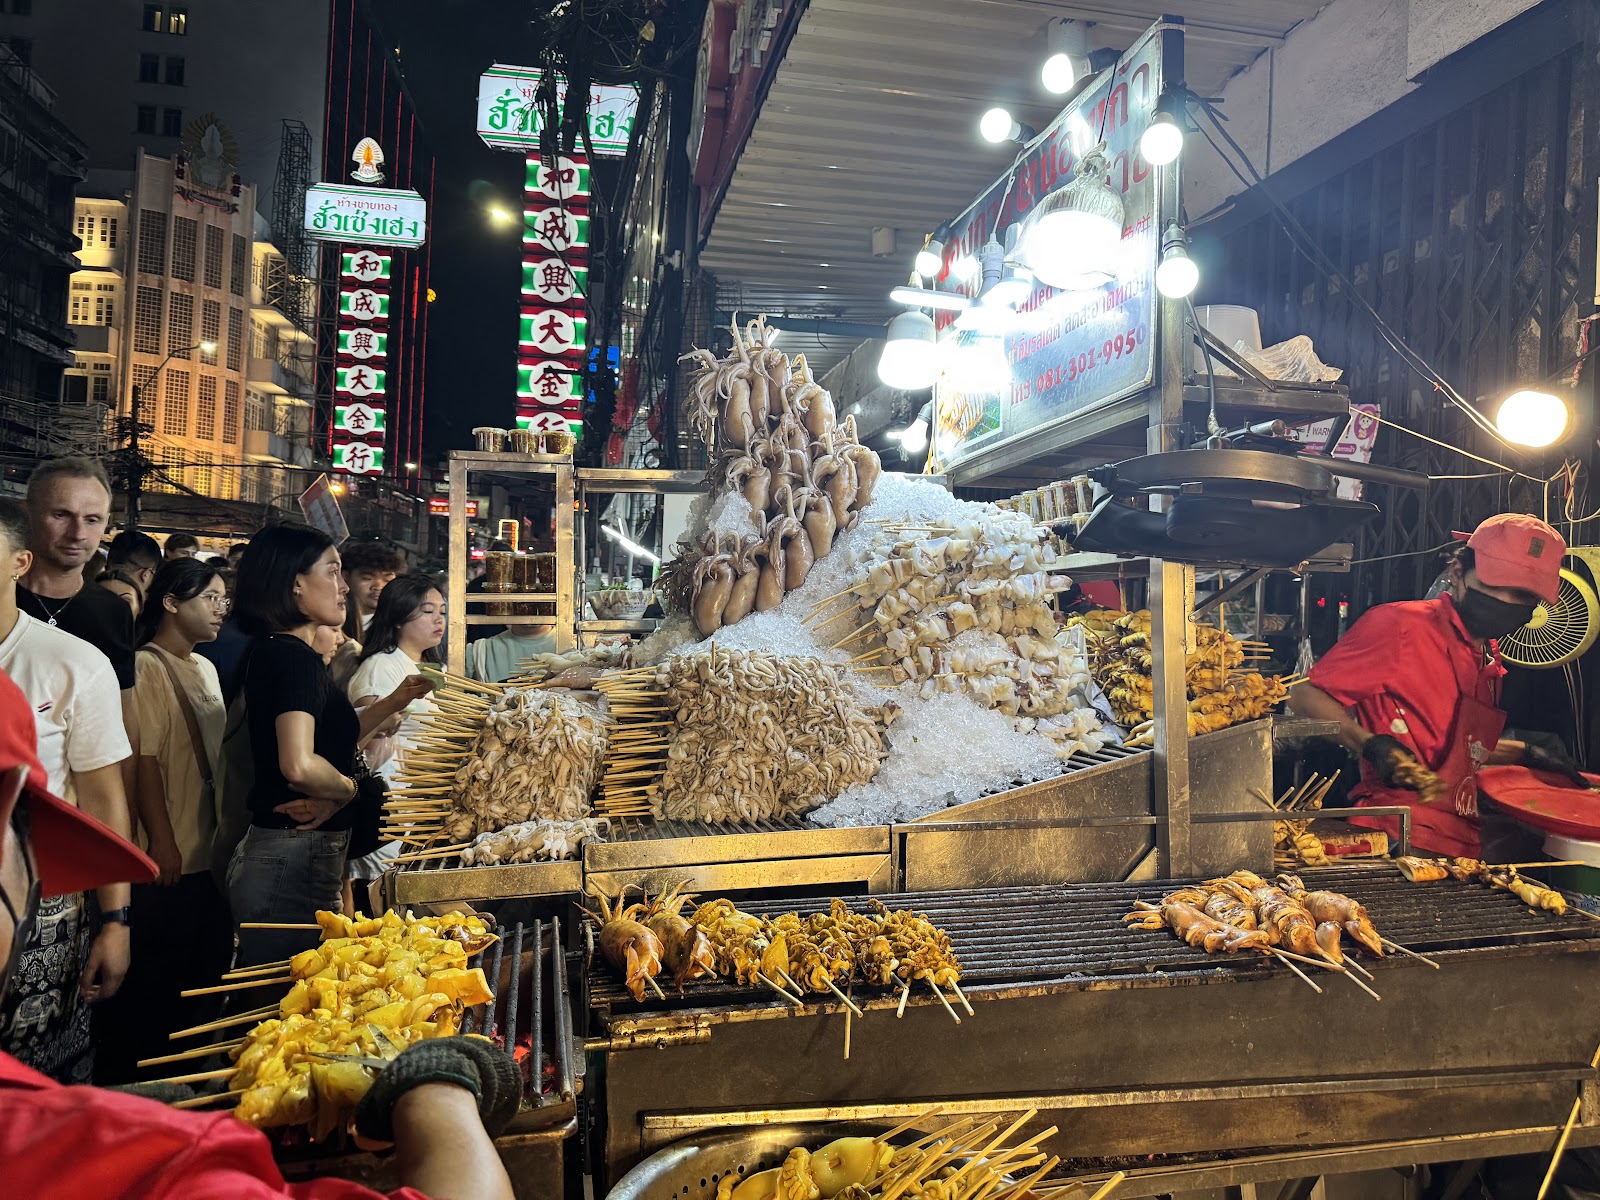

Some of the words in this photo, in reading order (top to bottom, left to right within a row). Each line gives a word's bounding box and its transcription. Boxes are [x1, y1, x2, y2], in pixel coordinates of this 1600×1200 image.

[312, 199, 418, 238] ฮั่วเซ่งเฮง
[346, 255, 379, 469] 和成興大金行
[1037, 322, 1147, 394] 081-301-9950
